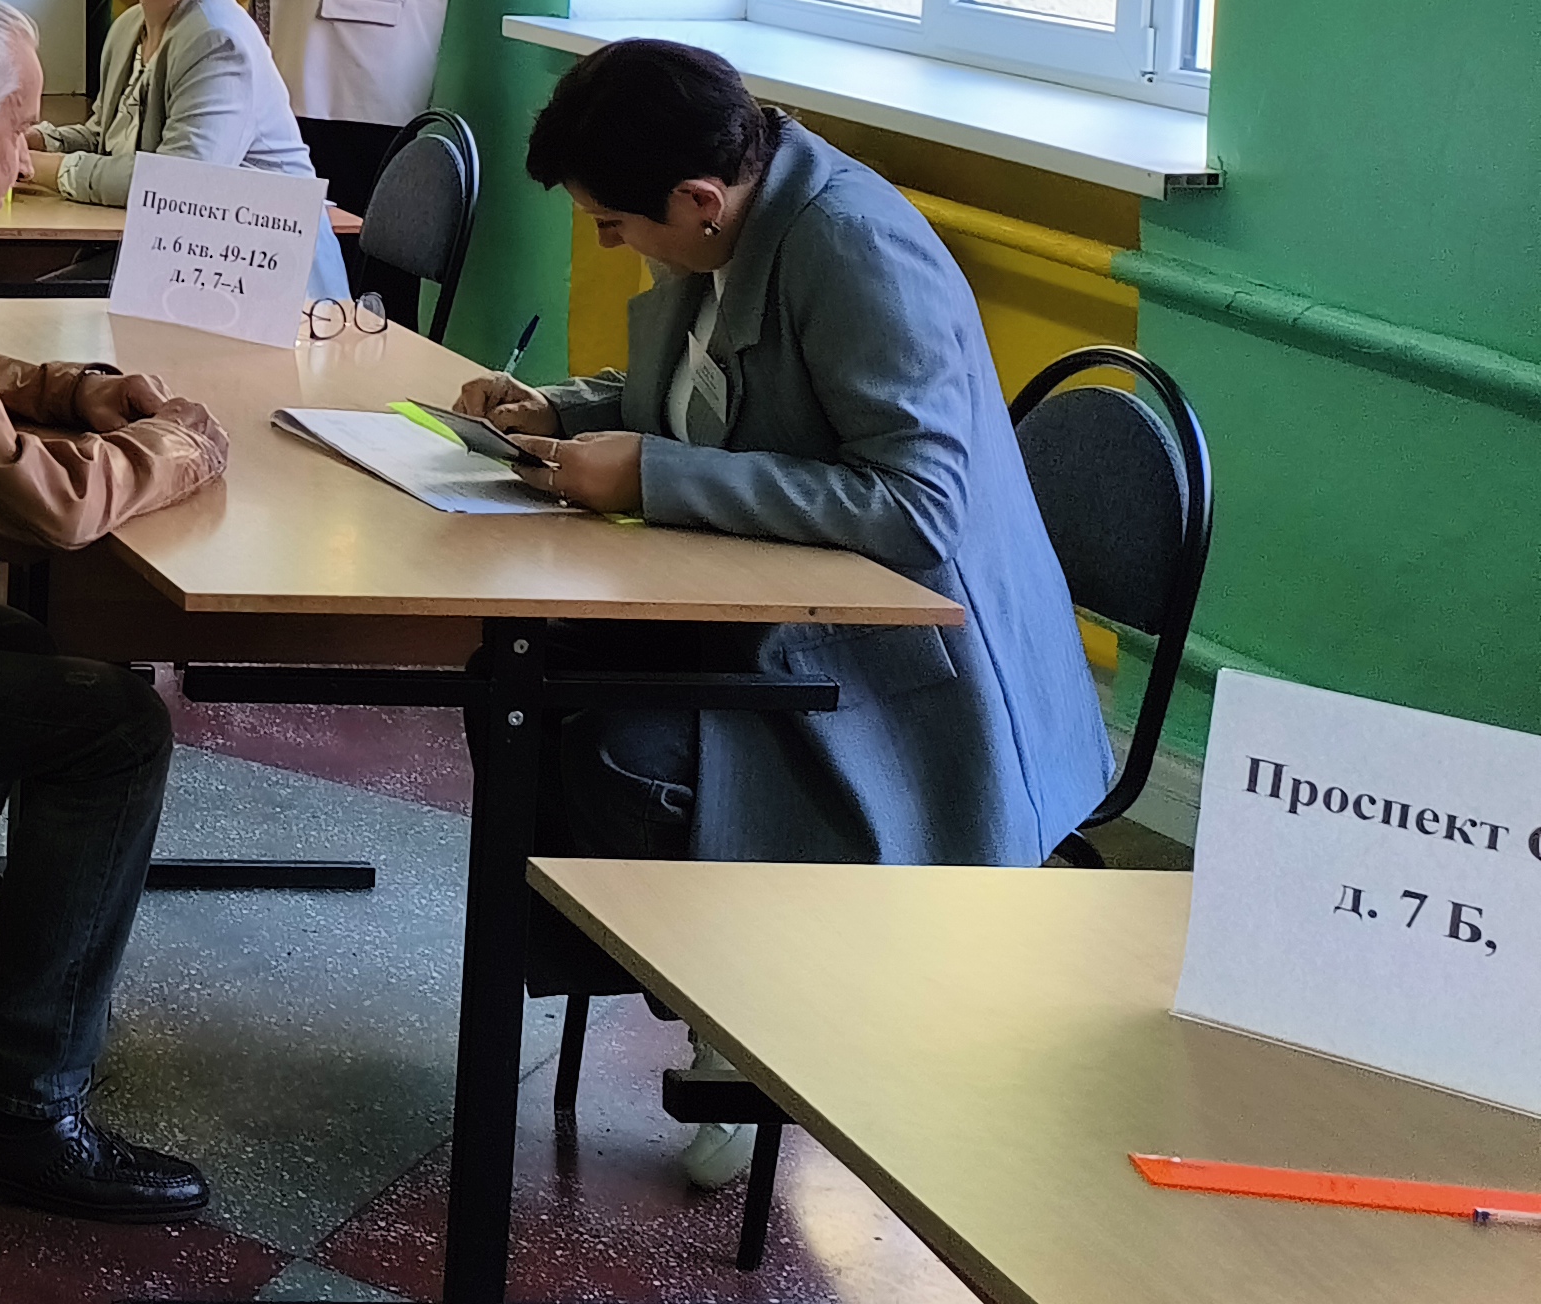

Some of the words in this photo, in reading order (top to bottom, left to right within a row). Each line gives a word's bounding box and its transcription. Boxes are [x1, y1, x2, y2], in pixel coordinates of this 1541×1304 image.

[142, 190, 230, 221] Проспект
[235, 205, 303, 238] Славы,
[151, 236, 167, 251] д.
[172, 235, 184, 253] 6
[187, 242, 214, 259] кв.
[219, 244, 279, 271] 49-126
[169, 268, 185, 283] д.
[193, 268, 206, 291] 7,
[1242, 755, 1510, 851] Проспект
[1333, 884, 1378, 920] д.
[1400, 889, 1428, 928] 7
[1443, 899, 1497, 957] Б,
